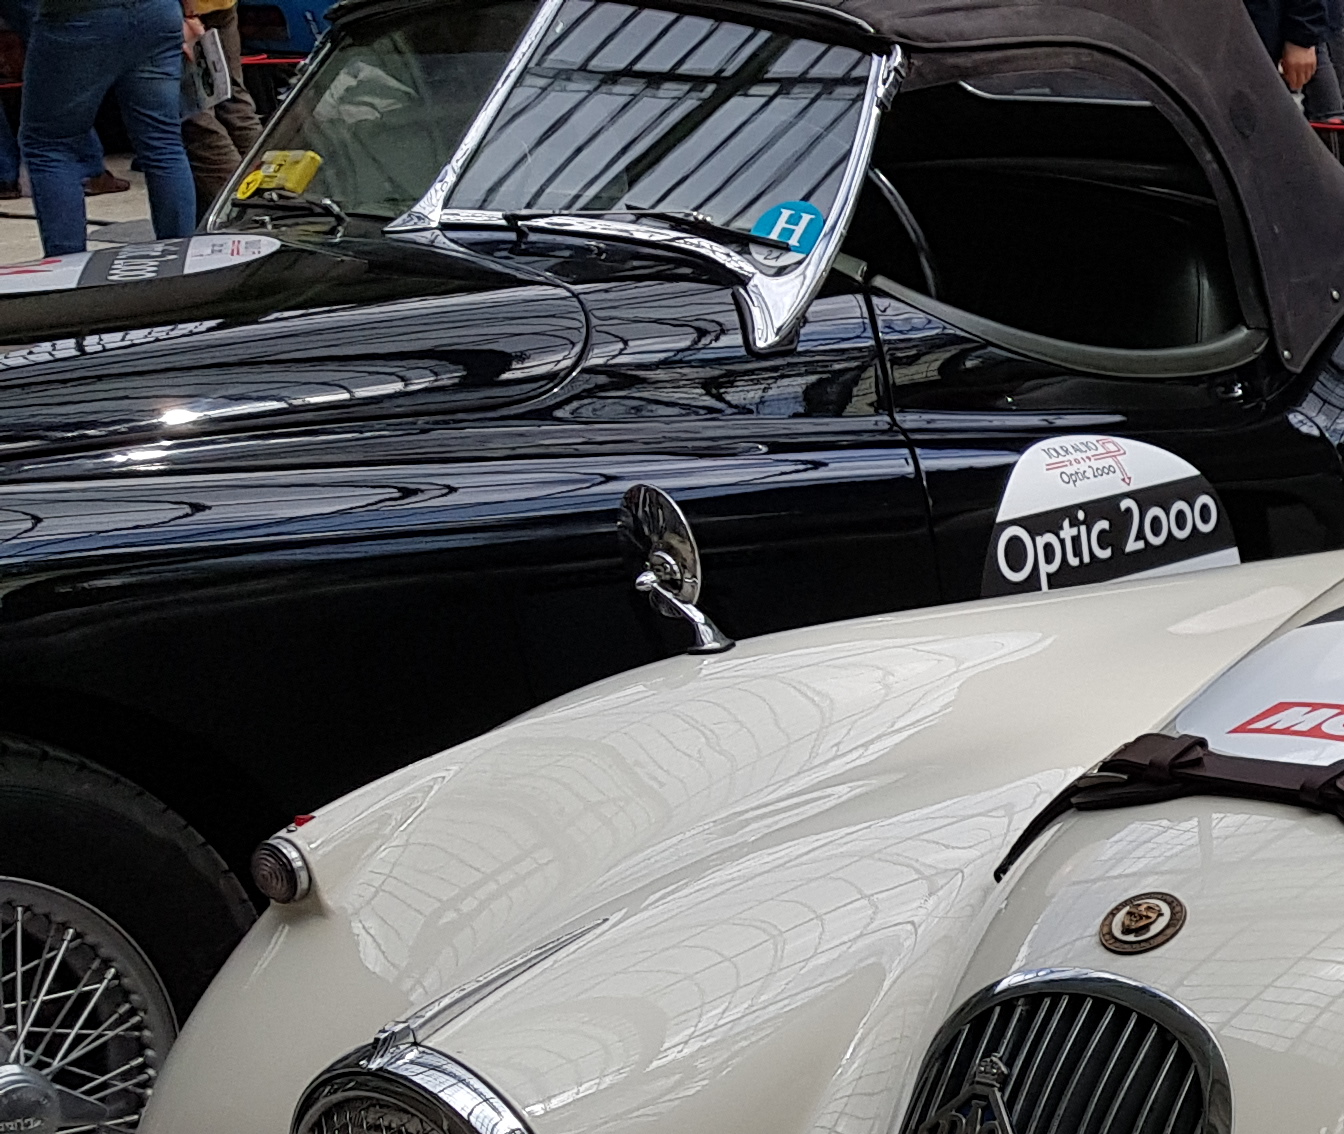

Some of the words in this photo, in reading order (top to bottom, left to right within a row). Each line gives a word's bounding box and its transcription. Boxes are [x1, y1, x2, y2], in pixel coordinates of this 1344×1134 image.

[768, 208, 816, 247] H
[1041, 443, 1073, 460] TOUR
[1072, 440, 1099, 455] AUTO
[1067, 455, 1092, 466] 2019
[1059, 465, 1090, 487] Optic
[1090, 464, 1116, 479] 2000
[997, 509, 1112, 592] Optic
[1120, 494, 1218, 553] 2000
